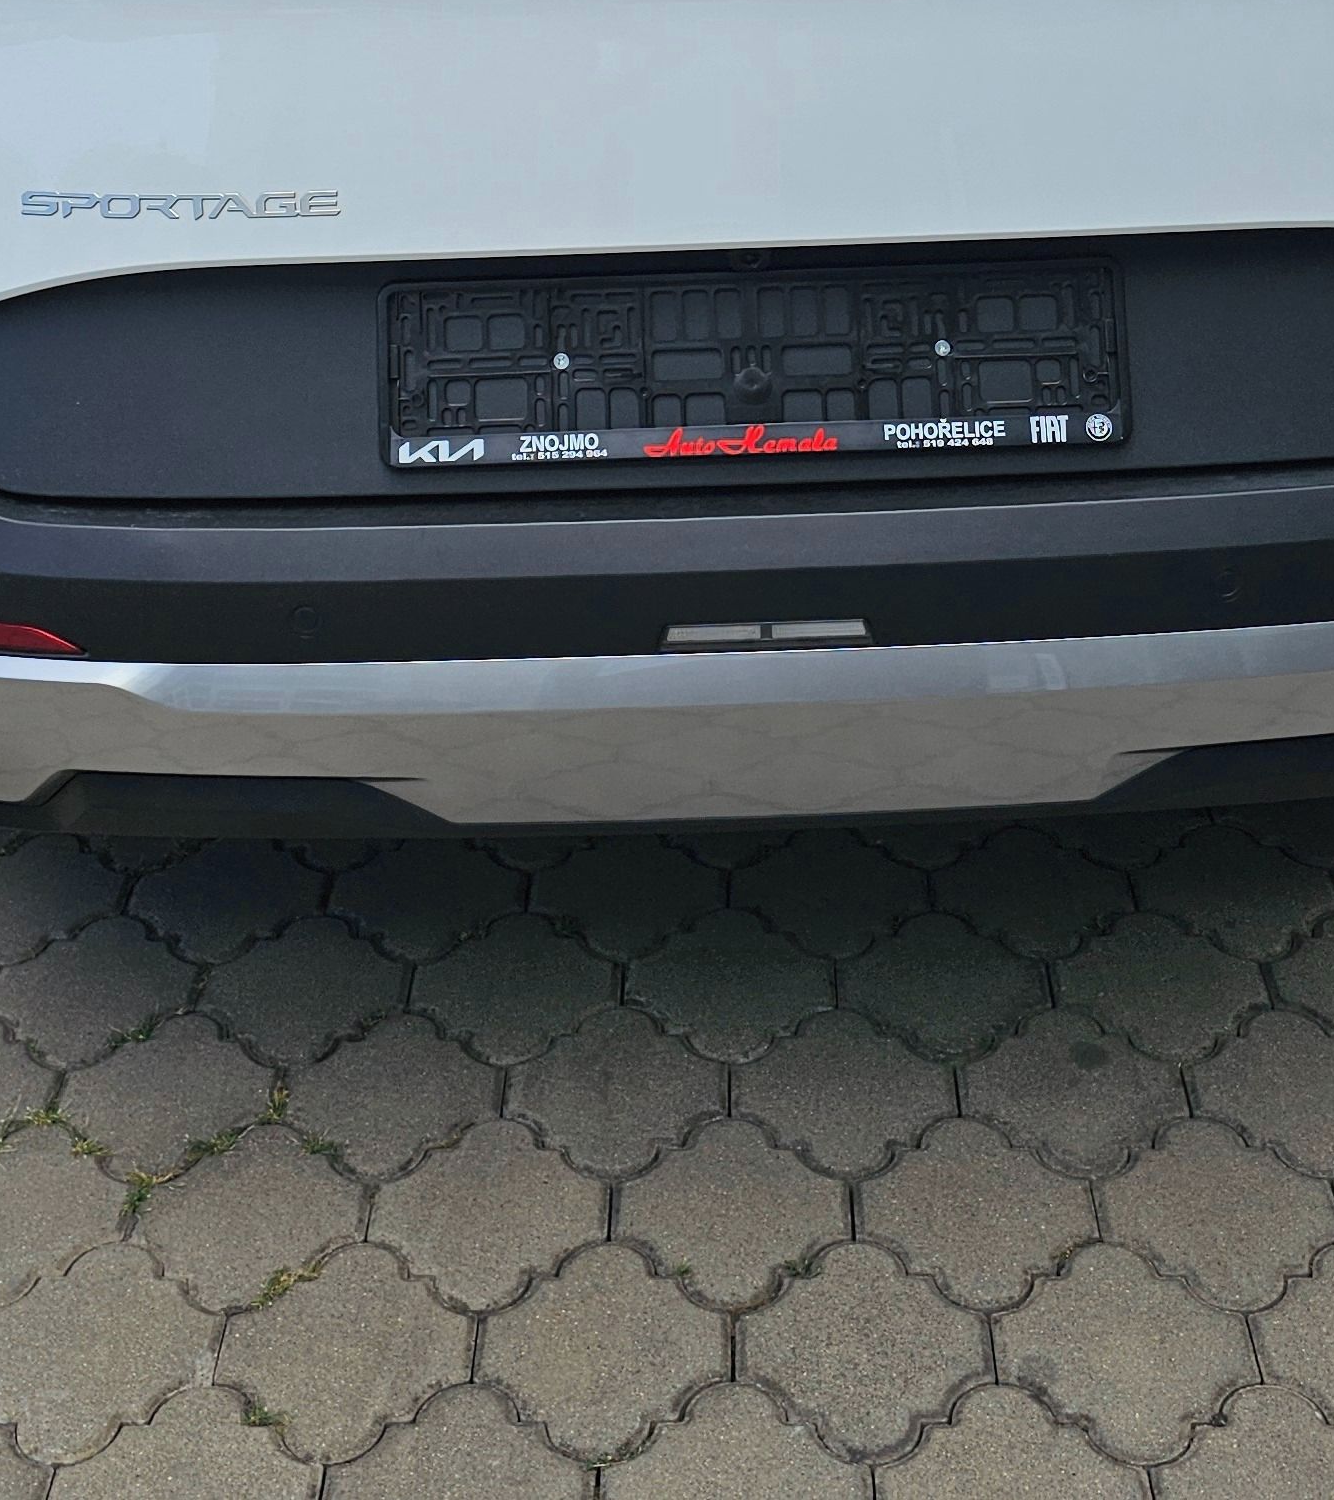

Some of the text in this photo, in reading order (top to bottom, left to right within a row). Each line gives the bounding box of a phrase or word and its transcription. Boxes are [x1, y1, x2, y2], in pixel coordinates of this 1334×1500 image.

[21, 190, 341, 220] SPORTAGE
[883, 418, 1006, 441] POHOŘELICE
[1029, 415, 1069, 444] FIAT
[398, 438, 485, 464] KIA
[519, 433, 600, 452] ZNOJMO
[947, 438, 969, 447] 424
